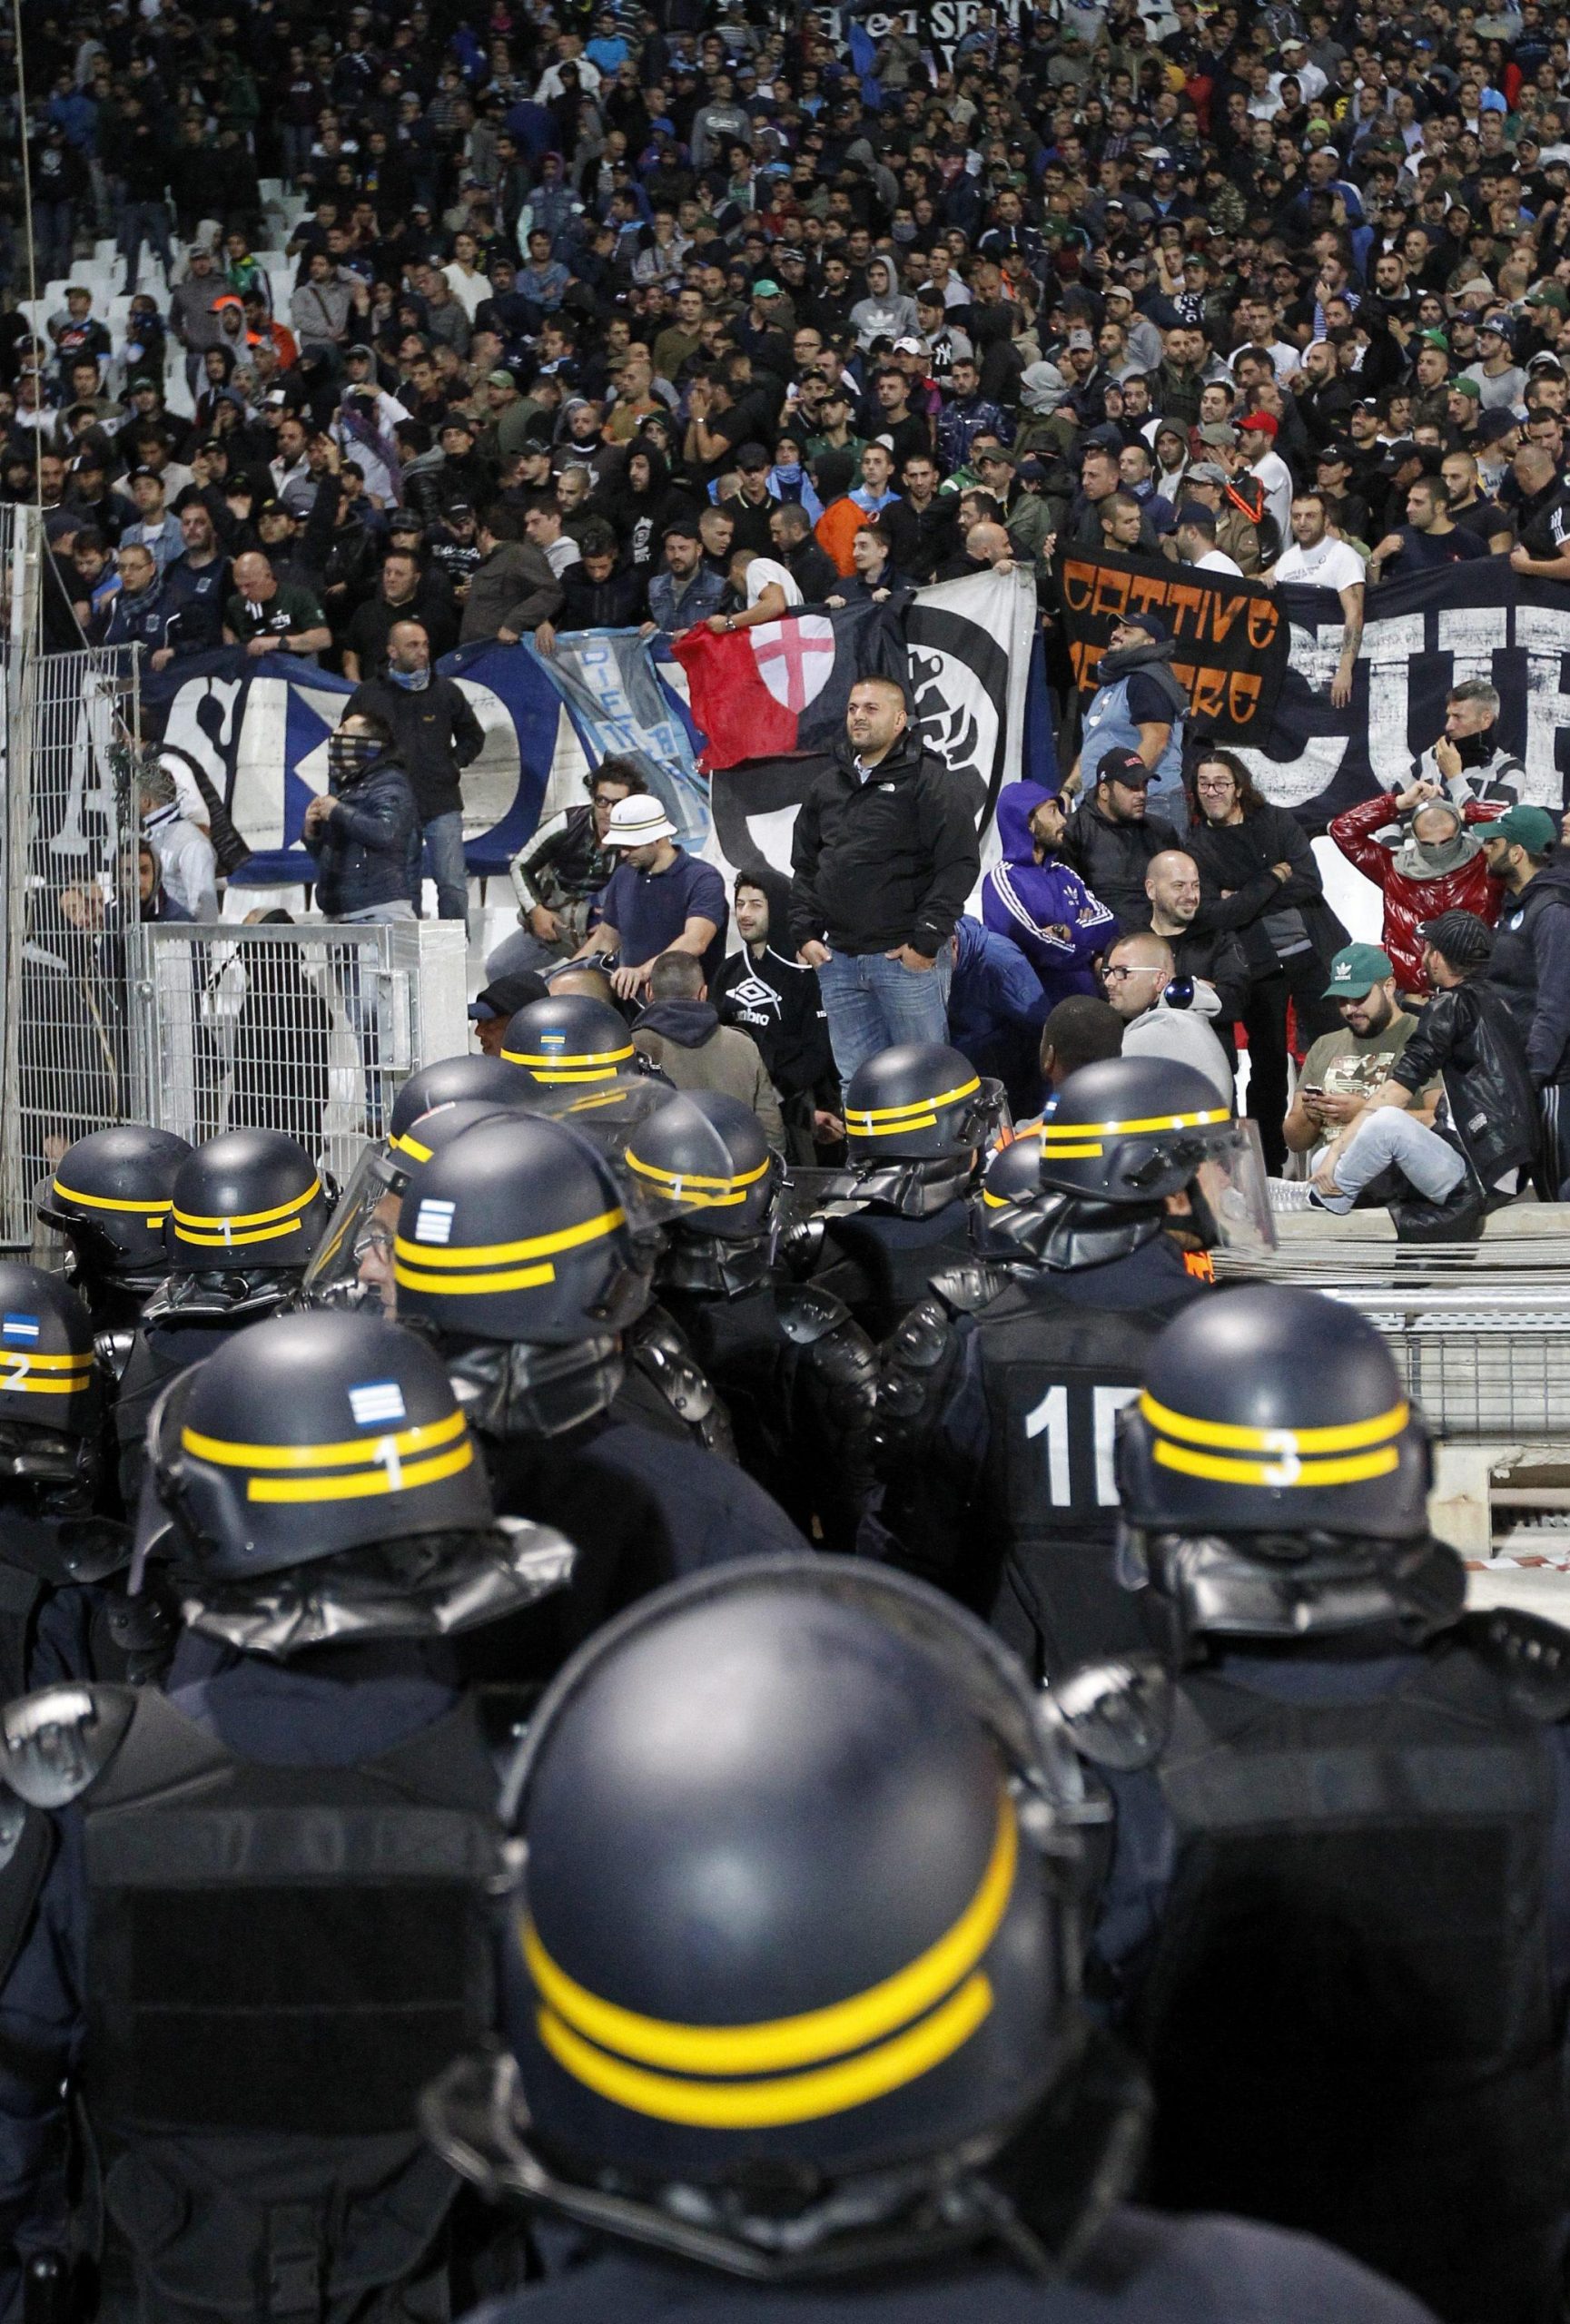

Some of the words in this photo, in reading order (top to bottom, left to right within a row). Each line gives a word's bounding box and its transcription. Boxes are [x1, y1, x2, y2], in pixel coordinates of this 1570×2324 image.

[863, 1110, 873, 1136] 1
[668, 1174, 683, 1201] 1
[218, 1216, 232, 1246] 1
[3, 1353, 29, 1392] 2
[373, 1433, 401, 1491] 1
[1263, 1429, 1301, 1486] 3
